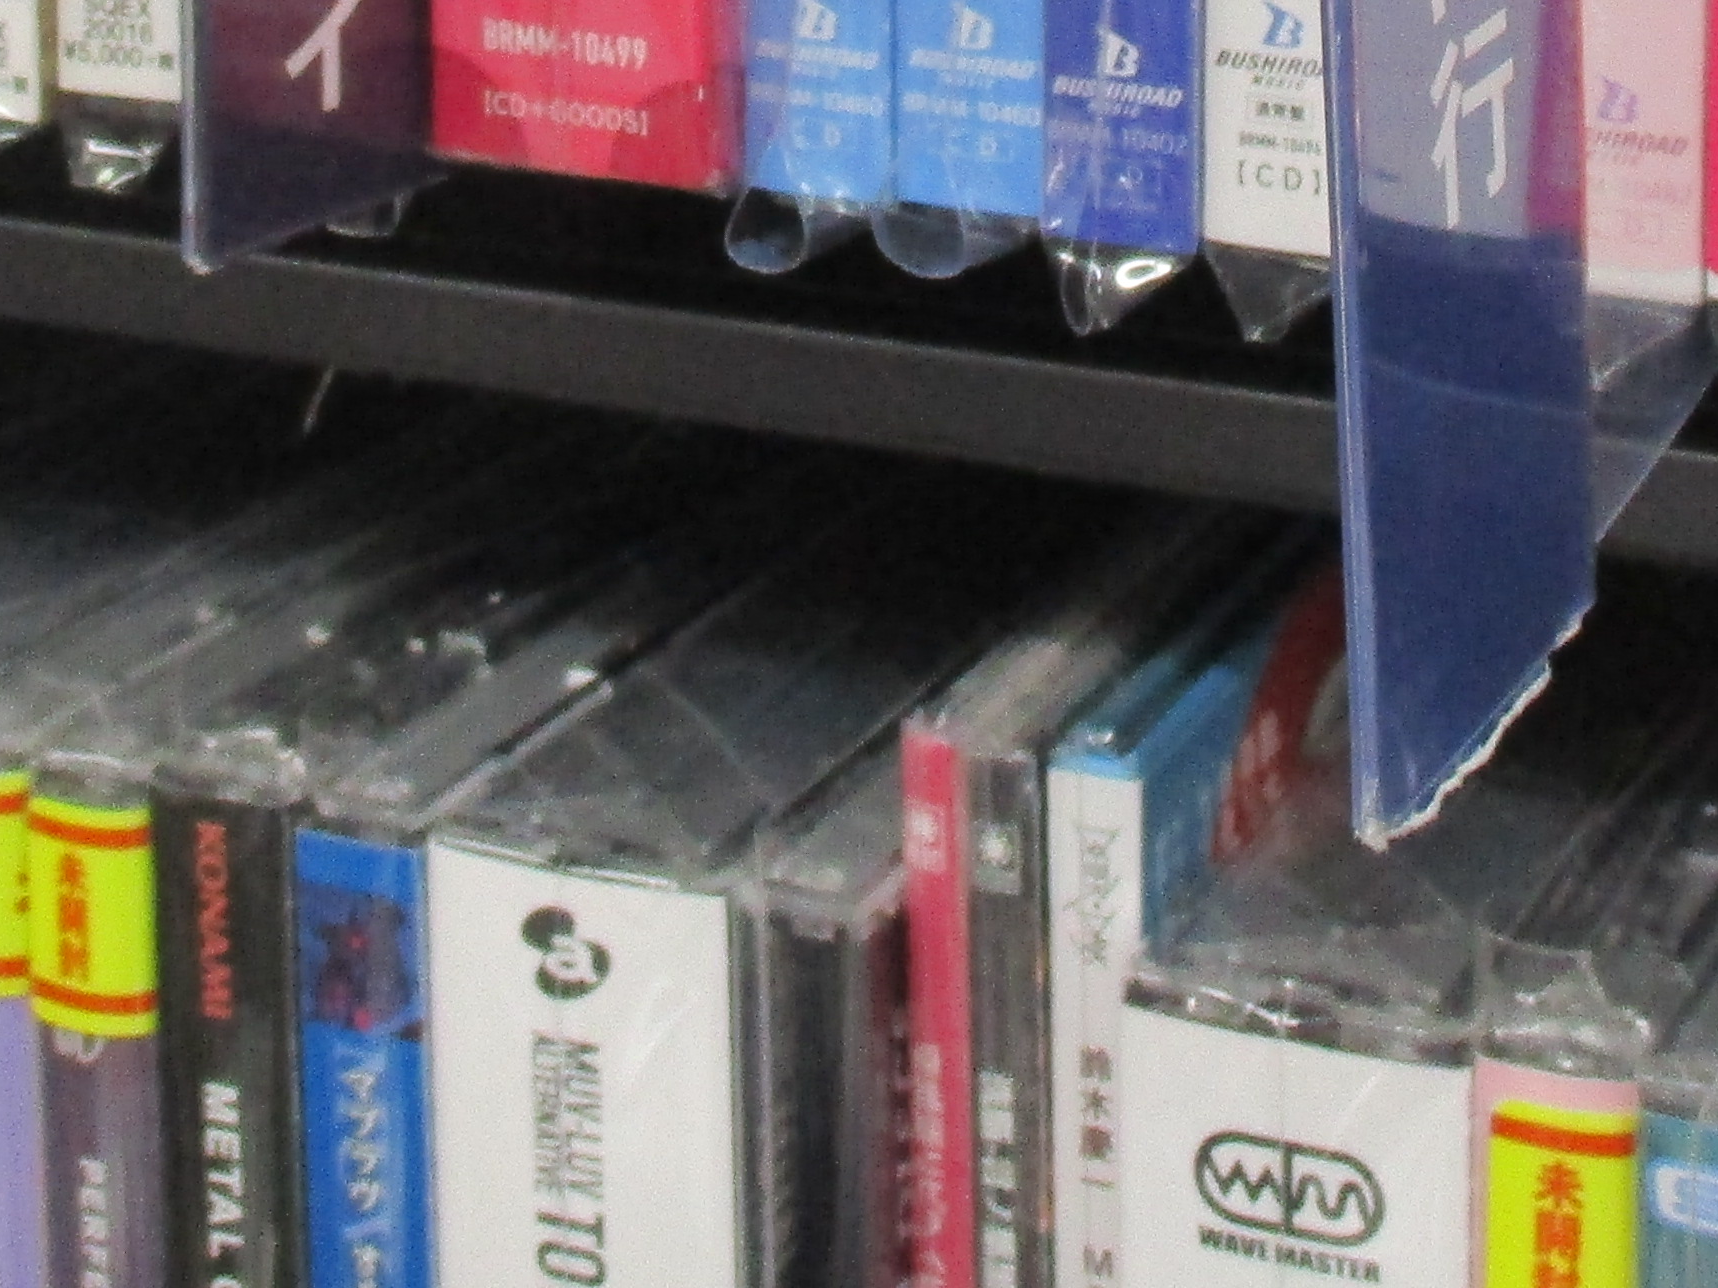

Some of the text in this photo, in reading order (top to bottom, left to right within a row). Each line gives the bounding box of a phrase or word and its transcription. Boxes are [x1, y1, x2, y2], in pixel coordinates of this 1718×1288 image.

[1214, 48, 1324, 82] BUSHIRO
[194, 821, 234, 1020] KONAMI
[201, 1079, 246, 1255] METAL
[530, 1031, 569, 1198] ALTERNATIVE
[563, 1038, 605, 1202] MUV-LUV
[1197, 1222, 1382, 1285] WAVE MASTER
